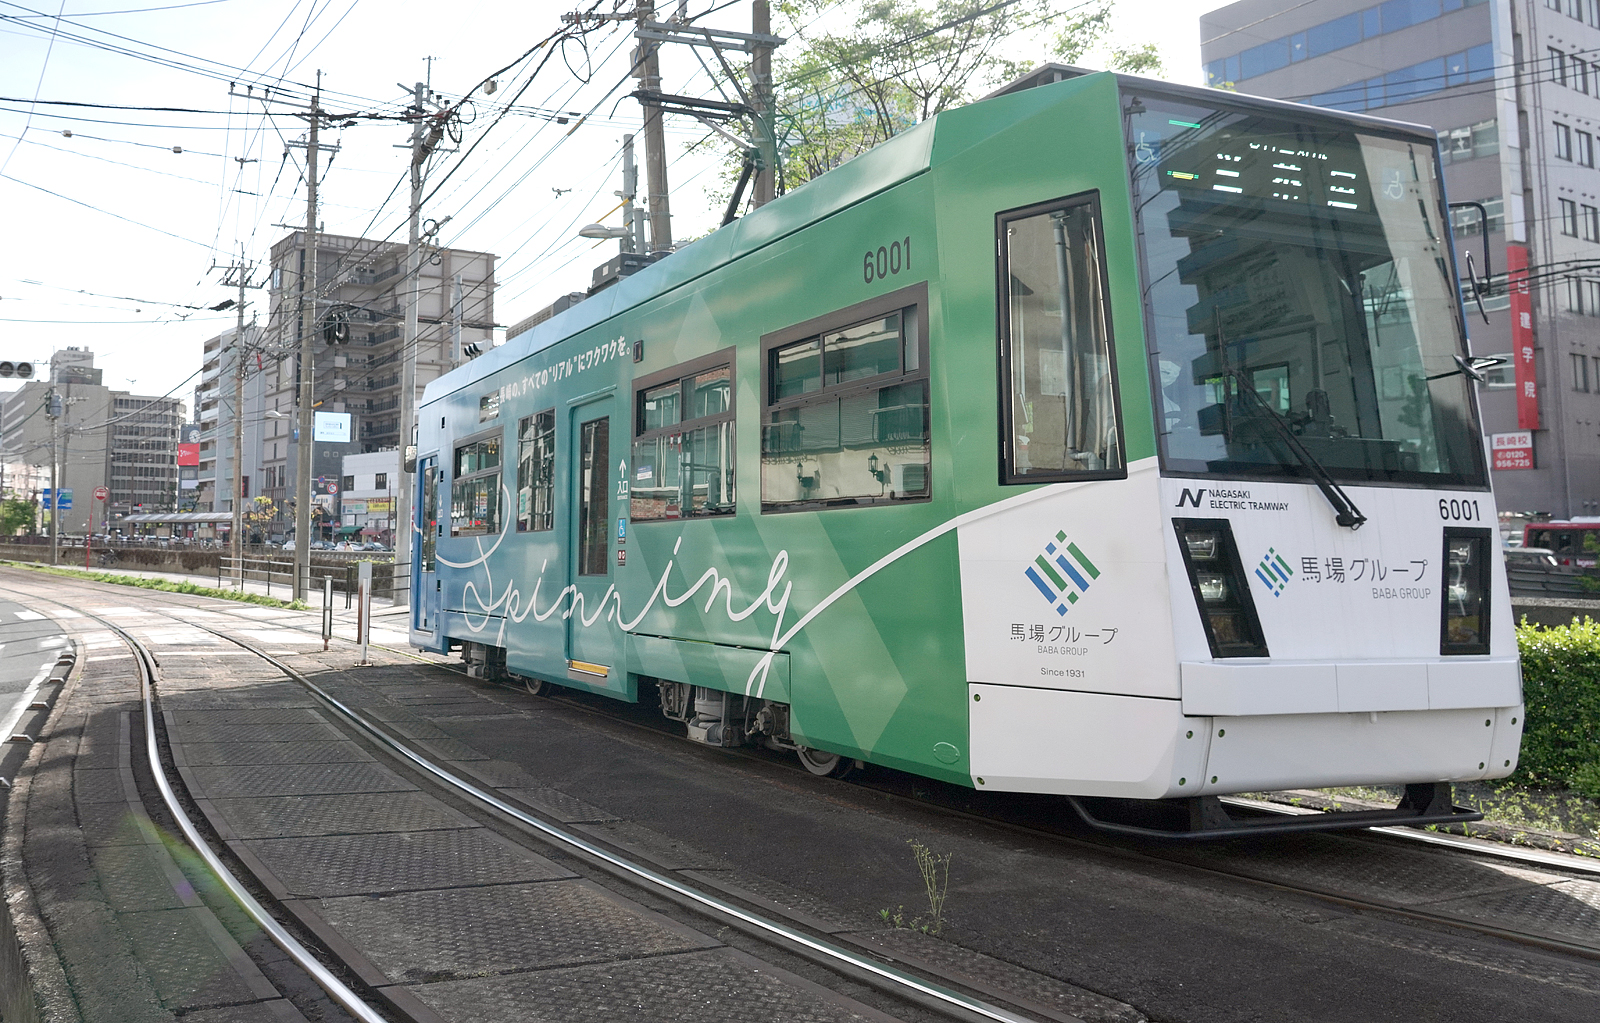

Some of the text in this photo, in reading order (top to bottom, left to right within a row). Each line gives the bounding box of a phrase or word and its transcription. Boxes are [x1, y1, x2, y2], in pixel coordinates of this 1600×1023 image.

[863, 236, 911, 284] 6001
[1495, 435, 1528, 447] 長崎校
[616, 480, 628, 494] 入口
[1208, 489, 1251, 499] NAGASAKI
[1210, 500, 1289, 511] ELECTRIC TRAMWAY
[1439, 498, 1481, 522] 6001
[1300, 556, 1429, 584] 馬場グループ
[1372, 587, 1431, 600] BABA GROUP
[1010, 623, 1119, 645] 馬場グループ
[1037, 645, 1089, 656] BABA GROUP
[1040, 667, 1086, 678] Since 1931
